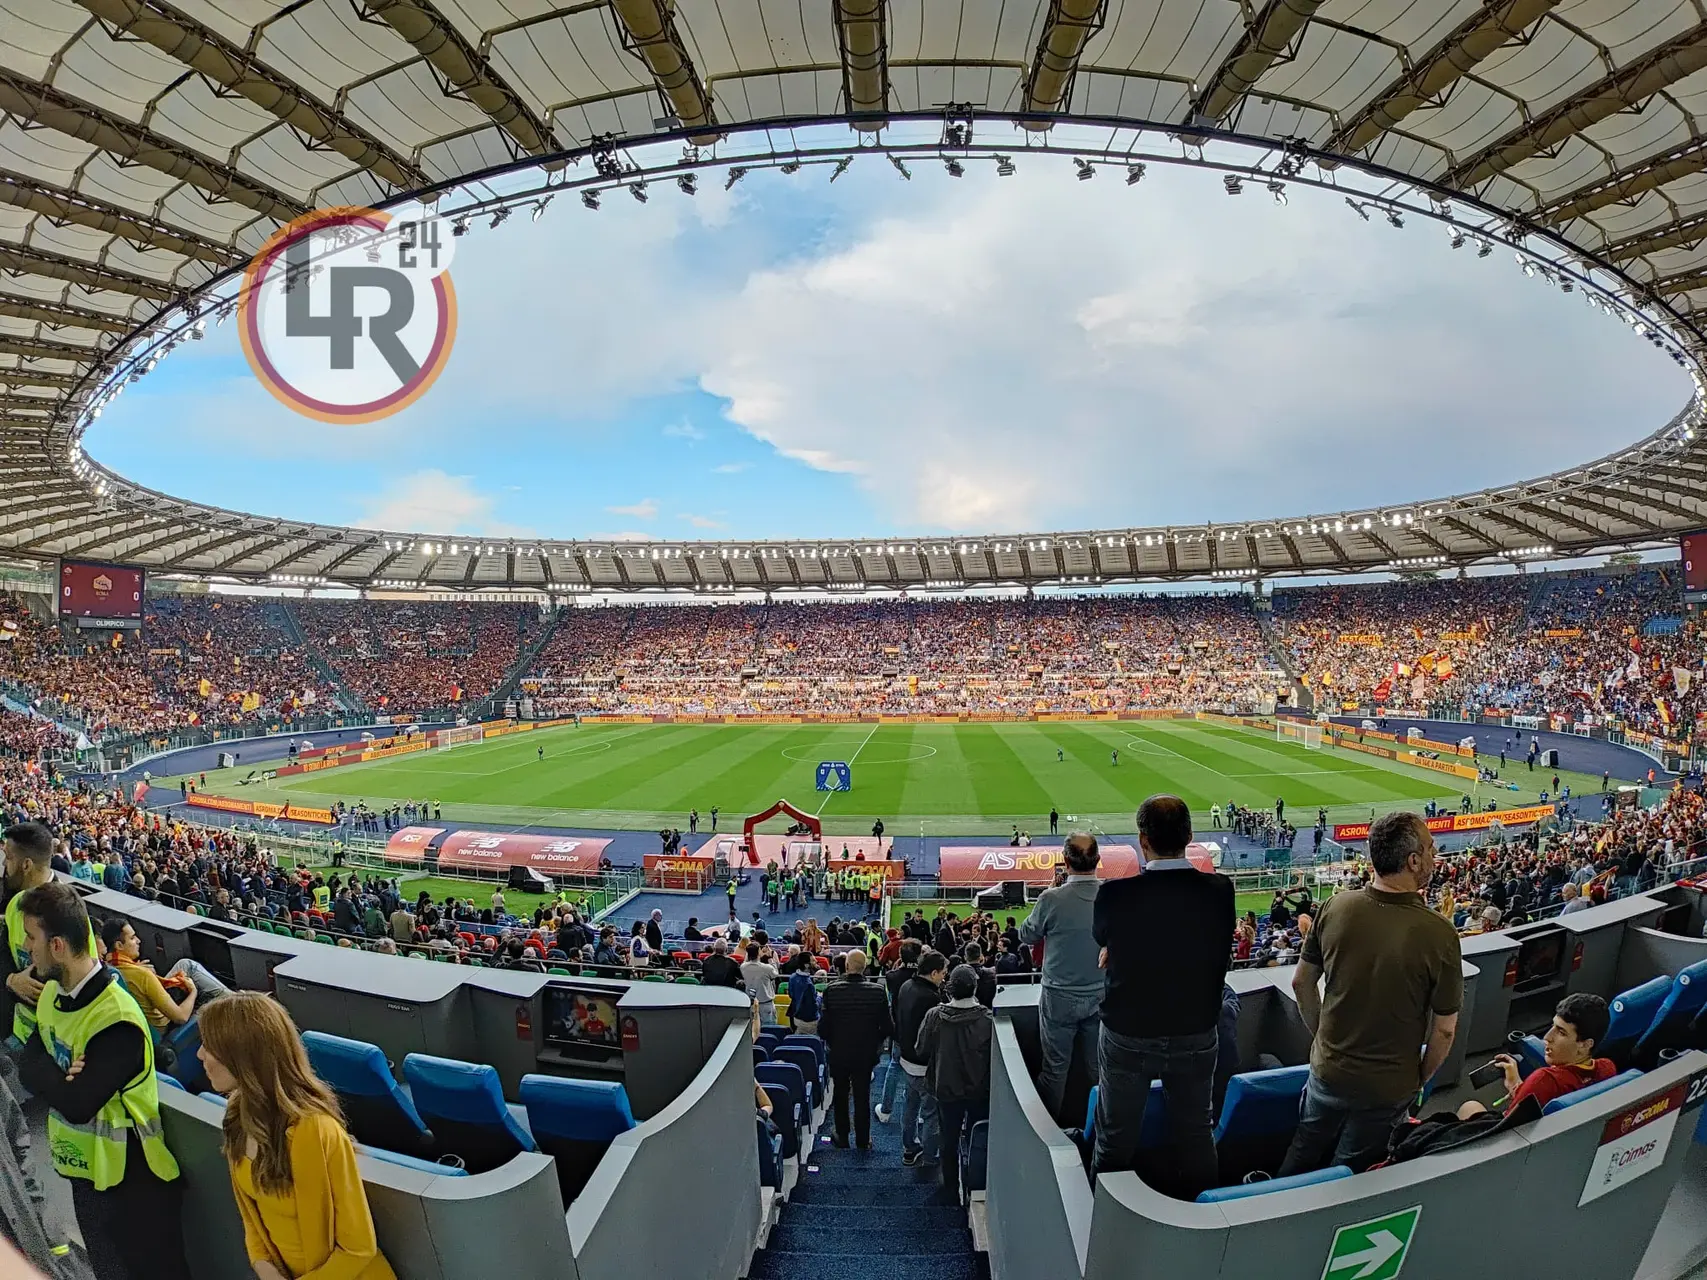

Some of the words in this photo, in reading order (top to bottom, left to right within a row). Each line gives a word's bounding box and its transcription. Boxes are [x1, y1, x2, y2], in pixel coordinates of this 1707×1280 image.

[1685, 560, 1692, 571] 0
[64, 586, 71, 597] 0
[133, 591, 140, 601] 0
[1410, 738, 1472, 755] ASROMA.COM/ABBONAENTI
[1435, 762, 1457, 773] PARTITA
[457, 848, 473, 857] new
[473, 848, 503, 858] balance
[530, 853, 547, 862] new
[547, 852, 580, 863] balance
[1618, 1139, 1658, 1167] Cimas
